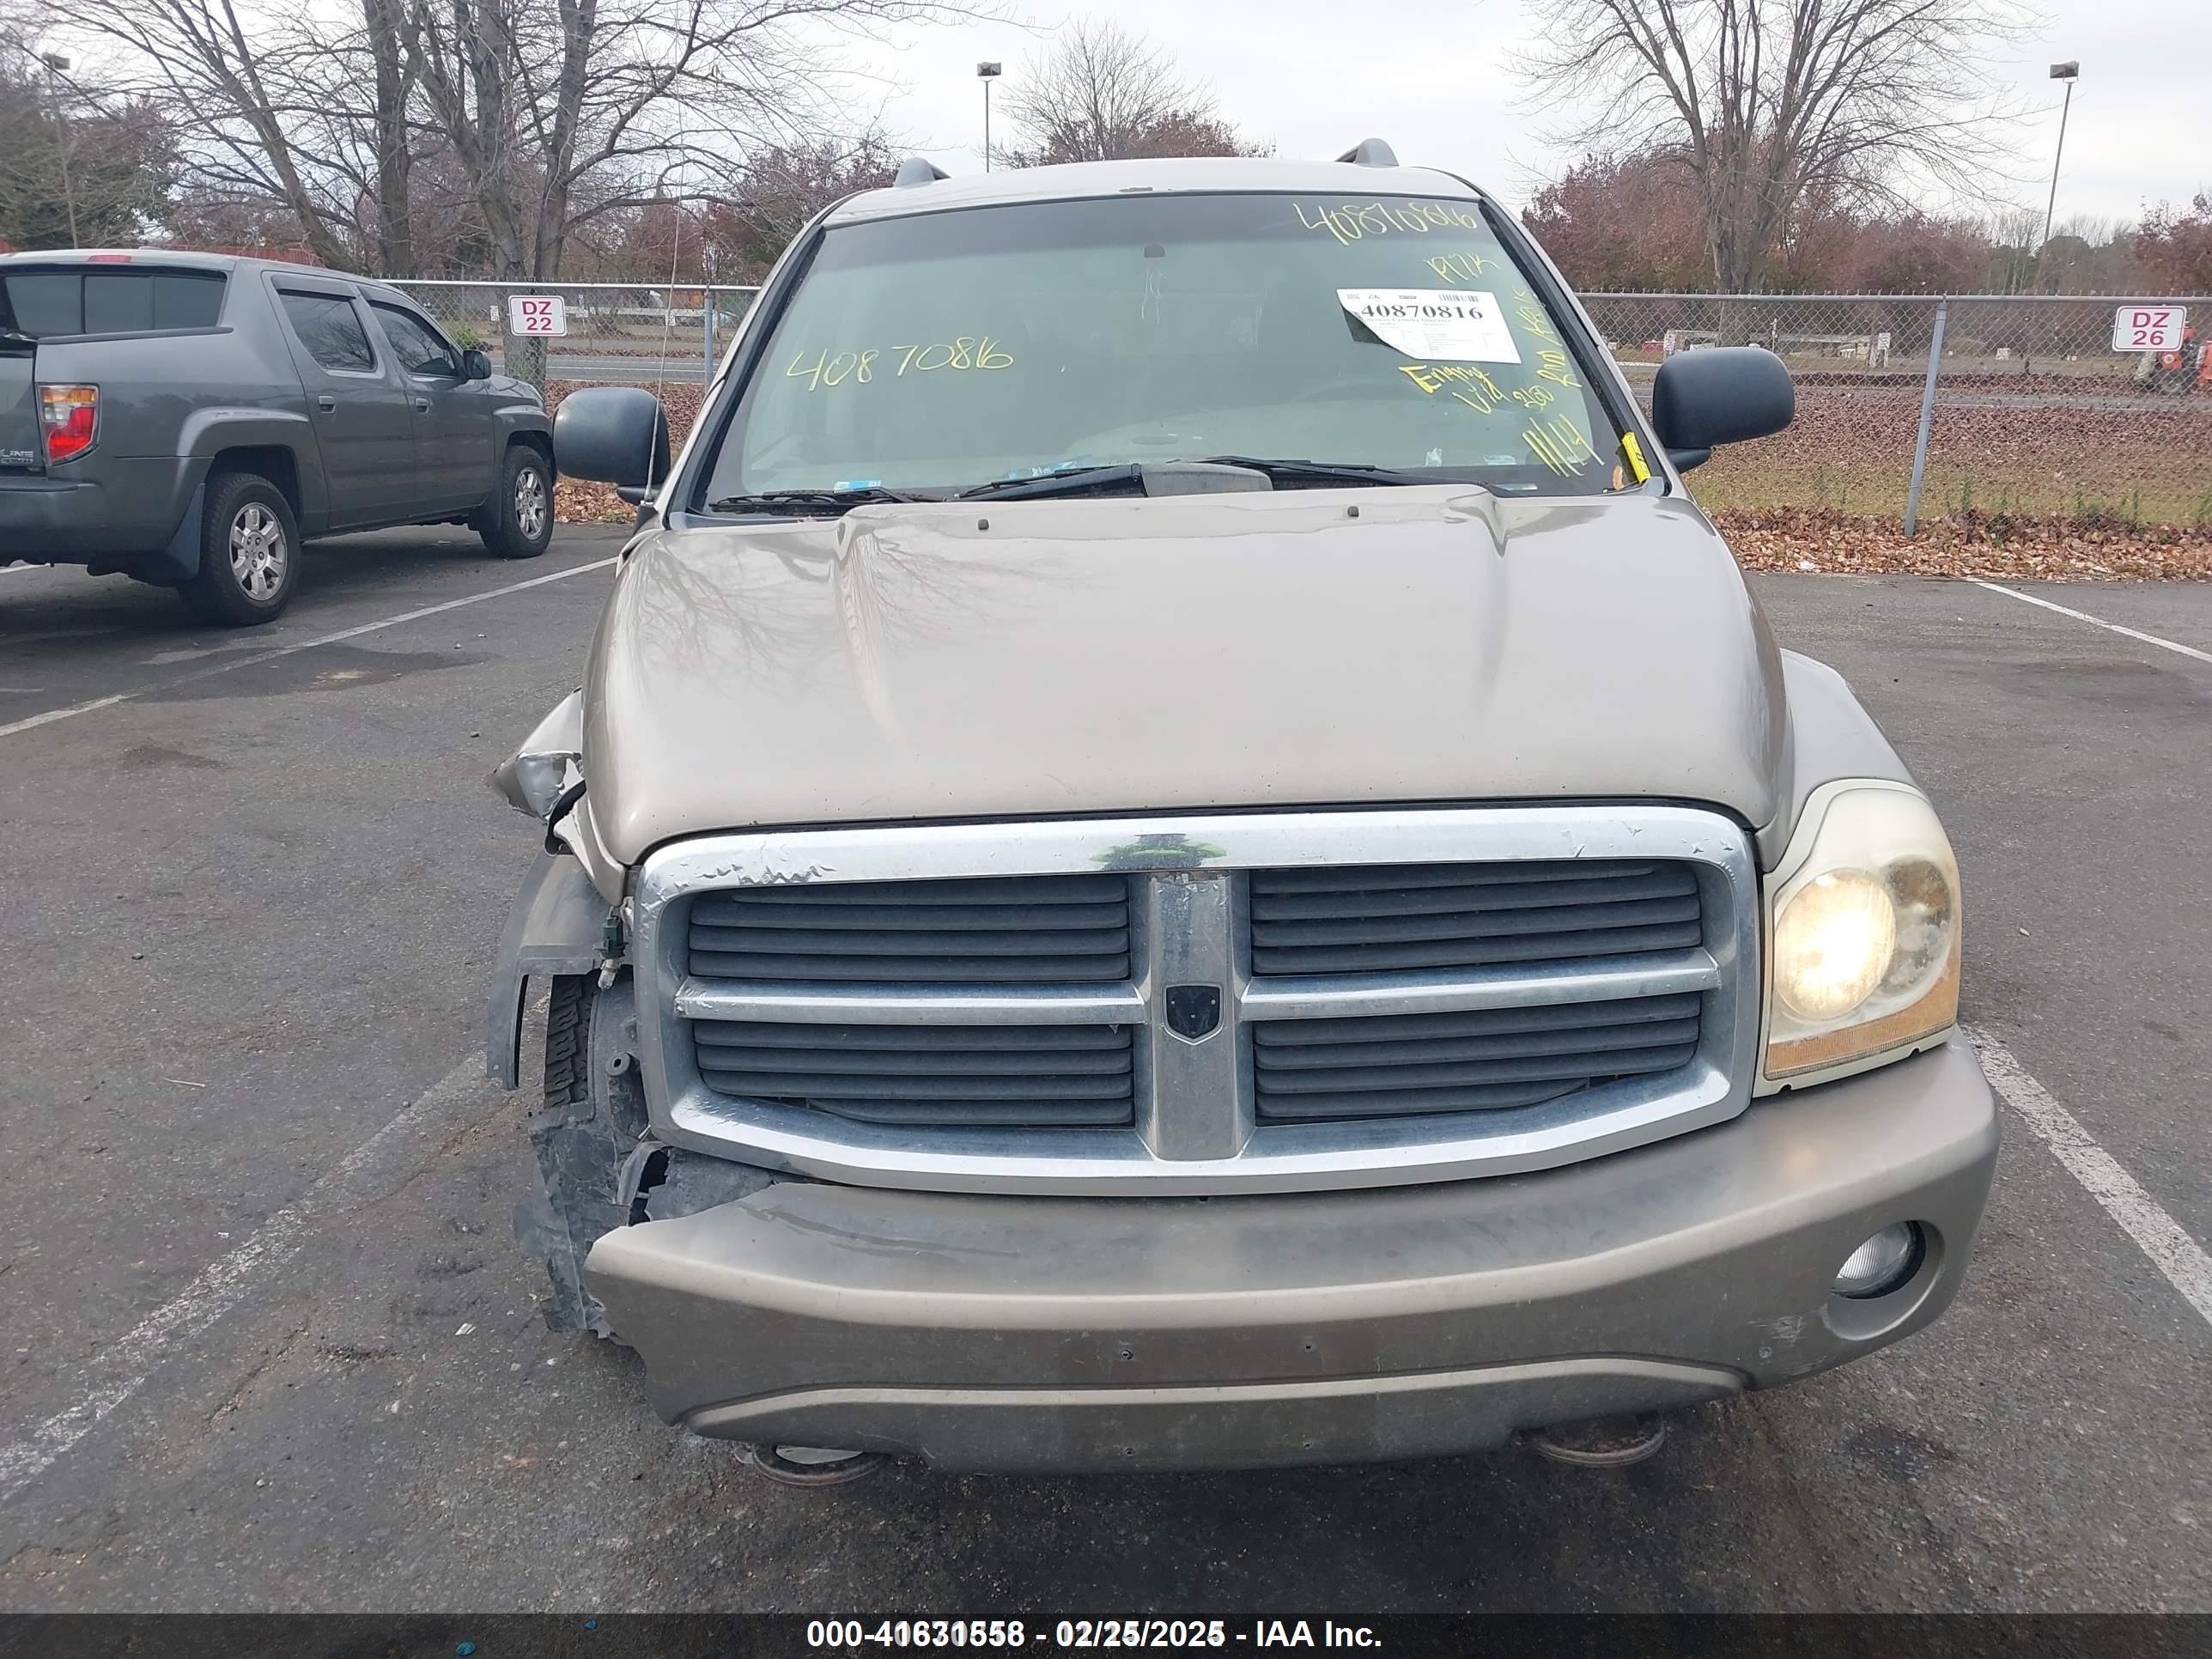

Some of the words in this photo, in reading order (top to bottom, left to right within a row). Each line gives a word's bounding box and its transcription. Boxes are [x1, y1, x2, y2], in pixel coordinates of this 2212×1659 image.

[521, 301, 552, 315] DZ
[1361, 304, 1484, 320] 40870816
[526, 317, 552, 331] 22
[2132, 313, 2171, 328] DZ
[2131, 330, 2165, 345] 26
